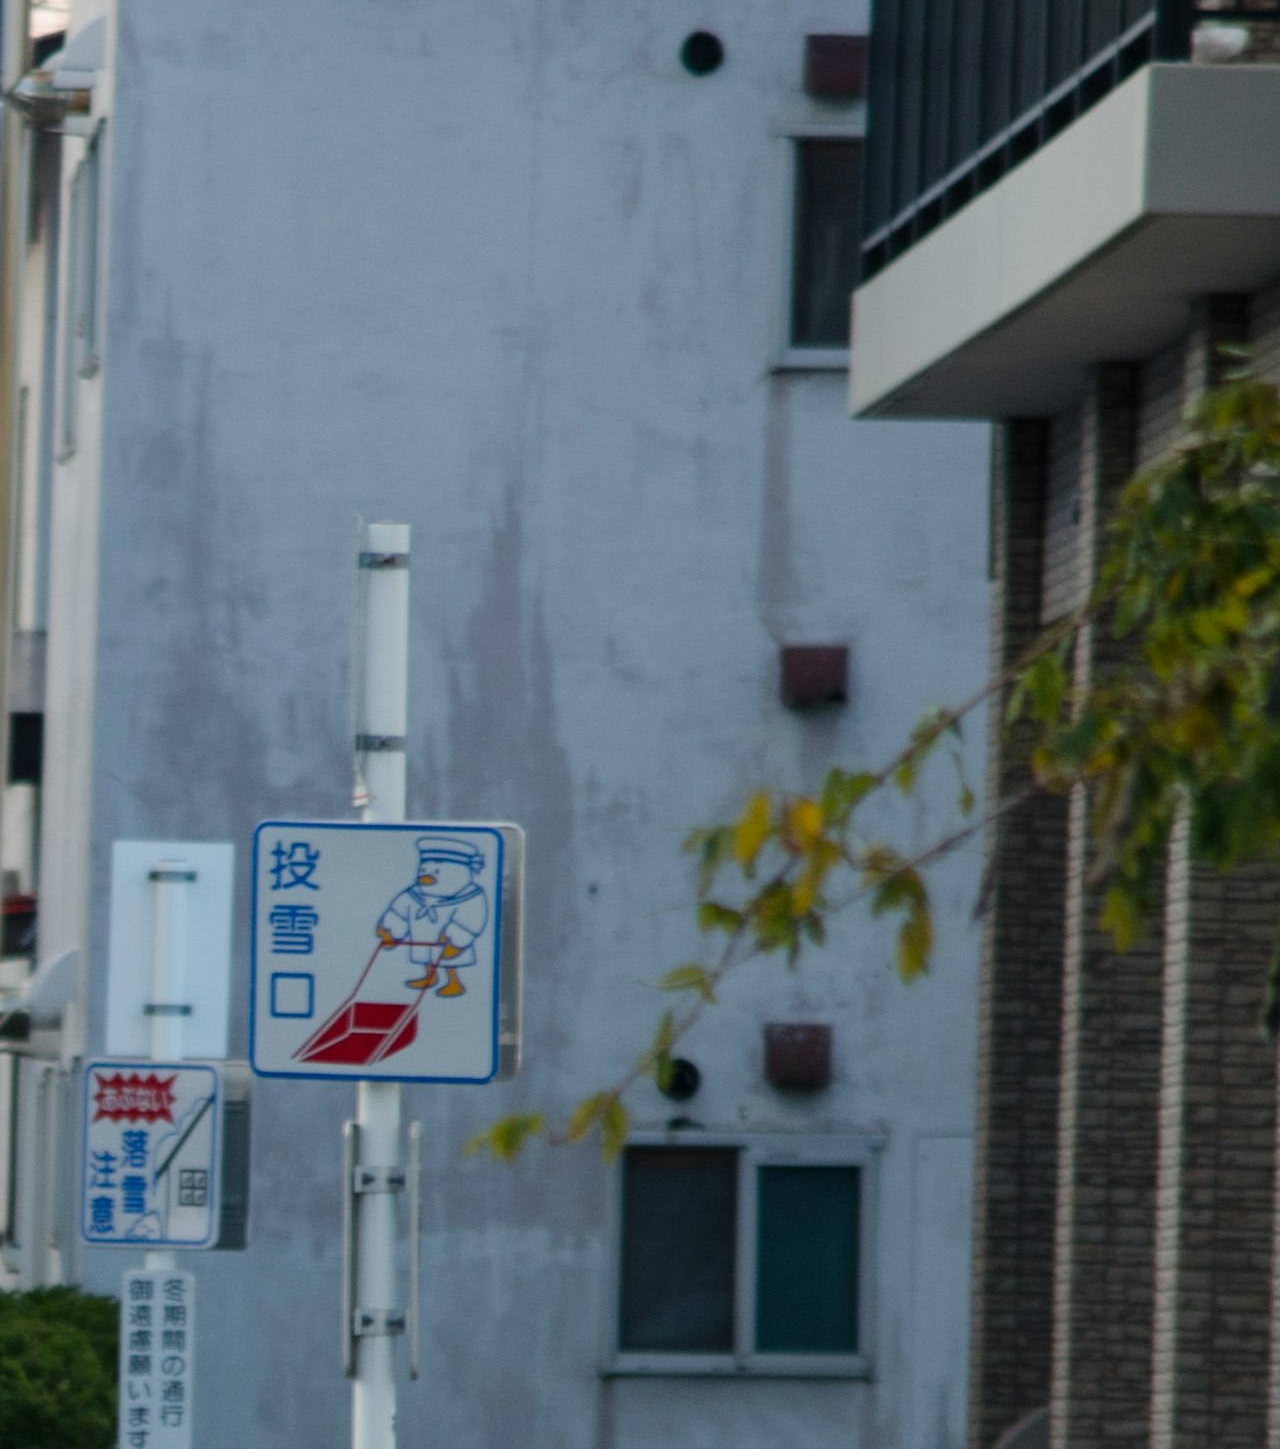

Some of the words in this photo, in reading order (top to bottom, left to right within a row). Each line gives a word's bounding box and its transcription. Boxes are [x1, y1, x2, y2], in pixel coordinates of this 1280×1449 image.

[269, 840, 321, 1019] 投雪口
[161, 1278, 187, 1429] 冬期間の通行
